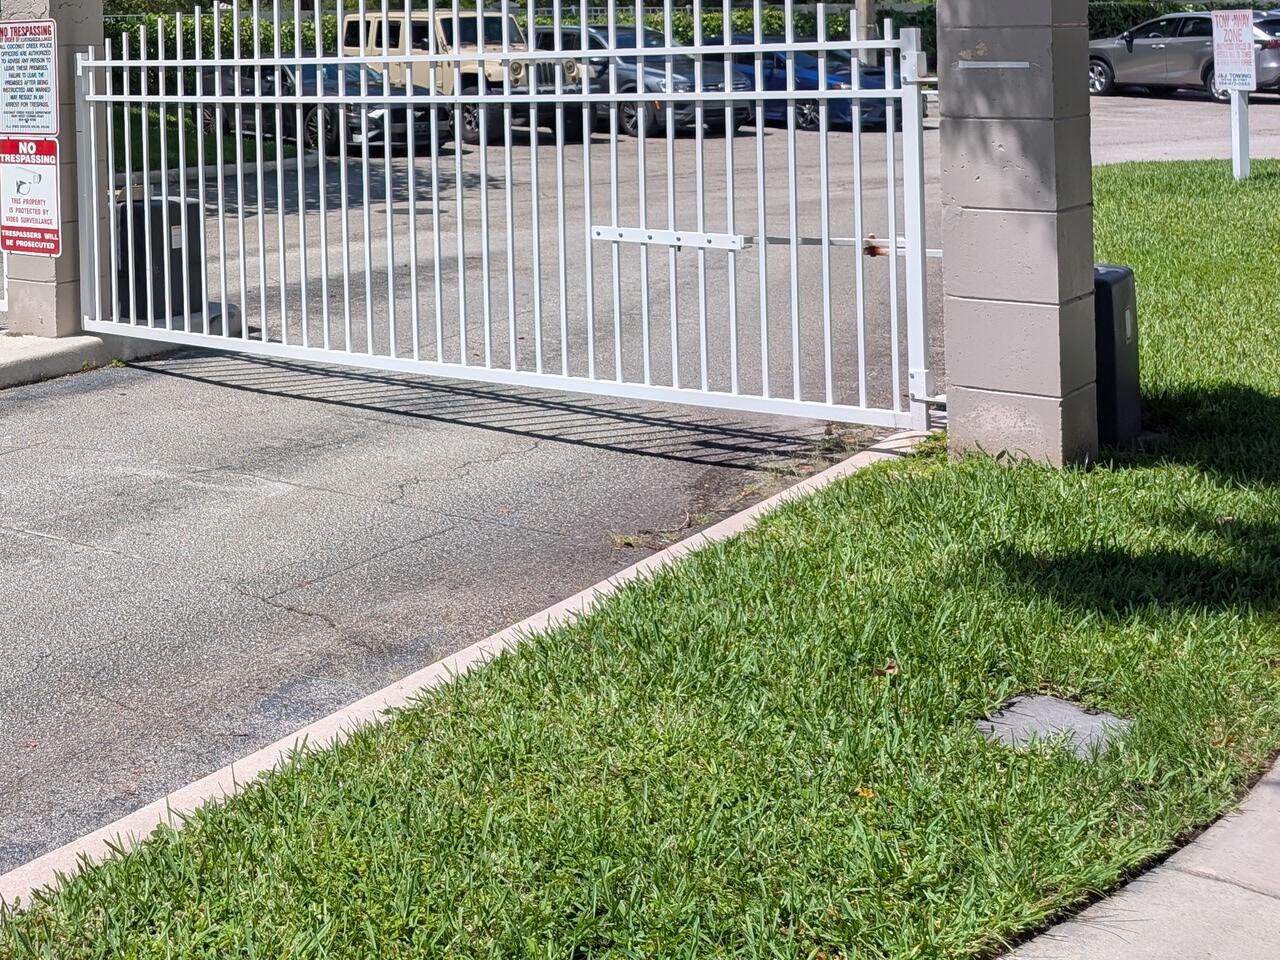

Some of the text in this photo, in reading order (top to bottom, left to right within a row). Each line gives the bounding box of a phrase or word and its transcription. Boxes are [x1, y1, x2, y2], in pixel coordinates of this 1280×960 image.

[0, 25, 52, 37] NO TRESPASSING
[1224, 29, 1242, 42] ZONE
[19, 142, 36, 154] NO
[0, 154, 56, 164] TRESPASSING
[21, 217, 53, 225] SURVEILLANCE
[1, 230, 41, 239] TRESPASSERS
[16, 240, 55, 249] PROSECUTED
